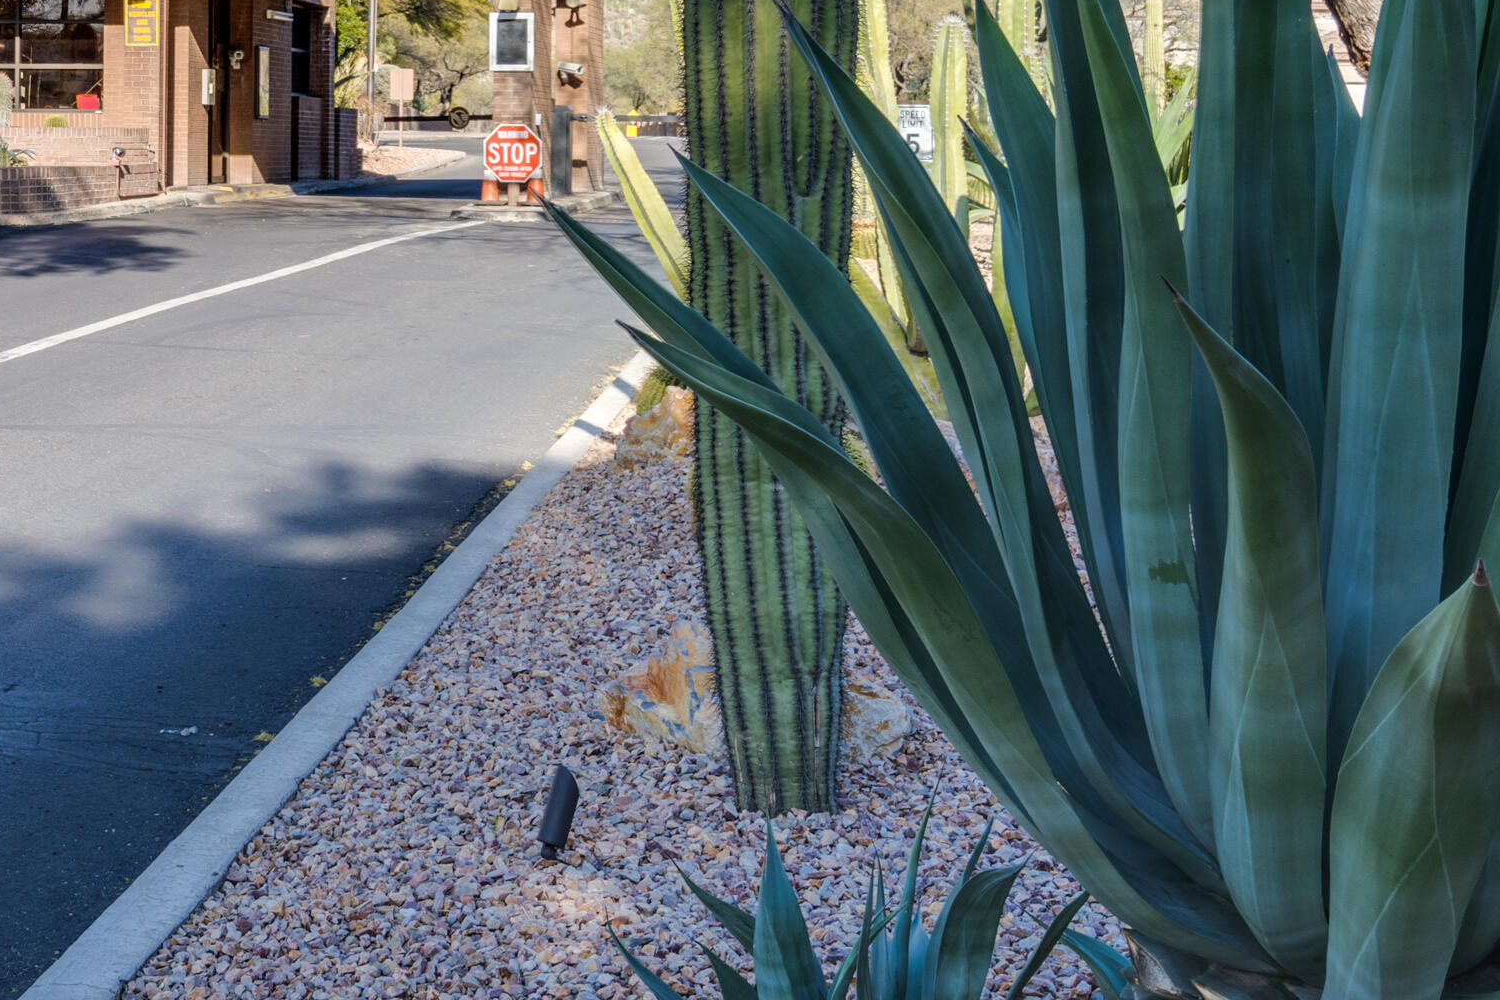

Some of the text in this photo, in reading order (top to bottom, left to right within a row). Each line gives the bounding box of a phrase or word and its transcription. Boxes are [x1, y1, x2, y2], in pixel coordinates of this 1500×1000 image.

[900, 110, 925, 119] SPEED
[902, 120, 924, 128] LIMIT
[497, 130, 529, 139] WARNING
[906, 133, 920, 154] 5
[488, 142, 538, 164] STOP
